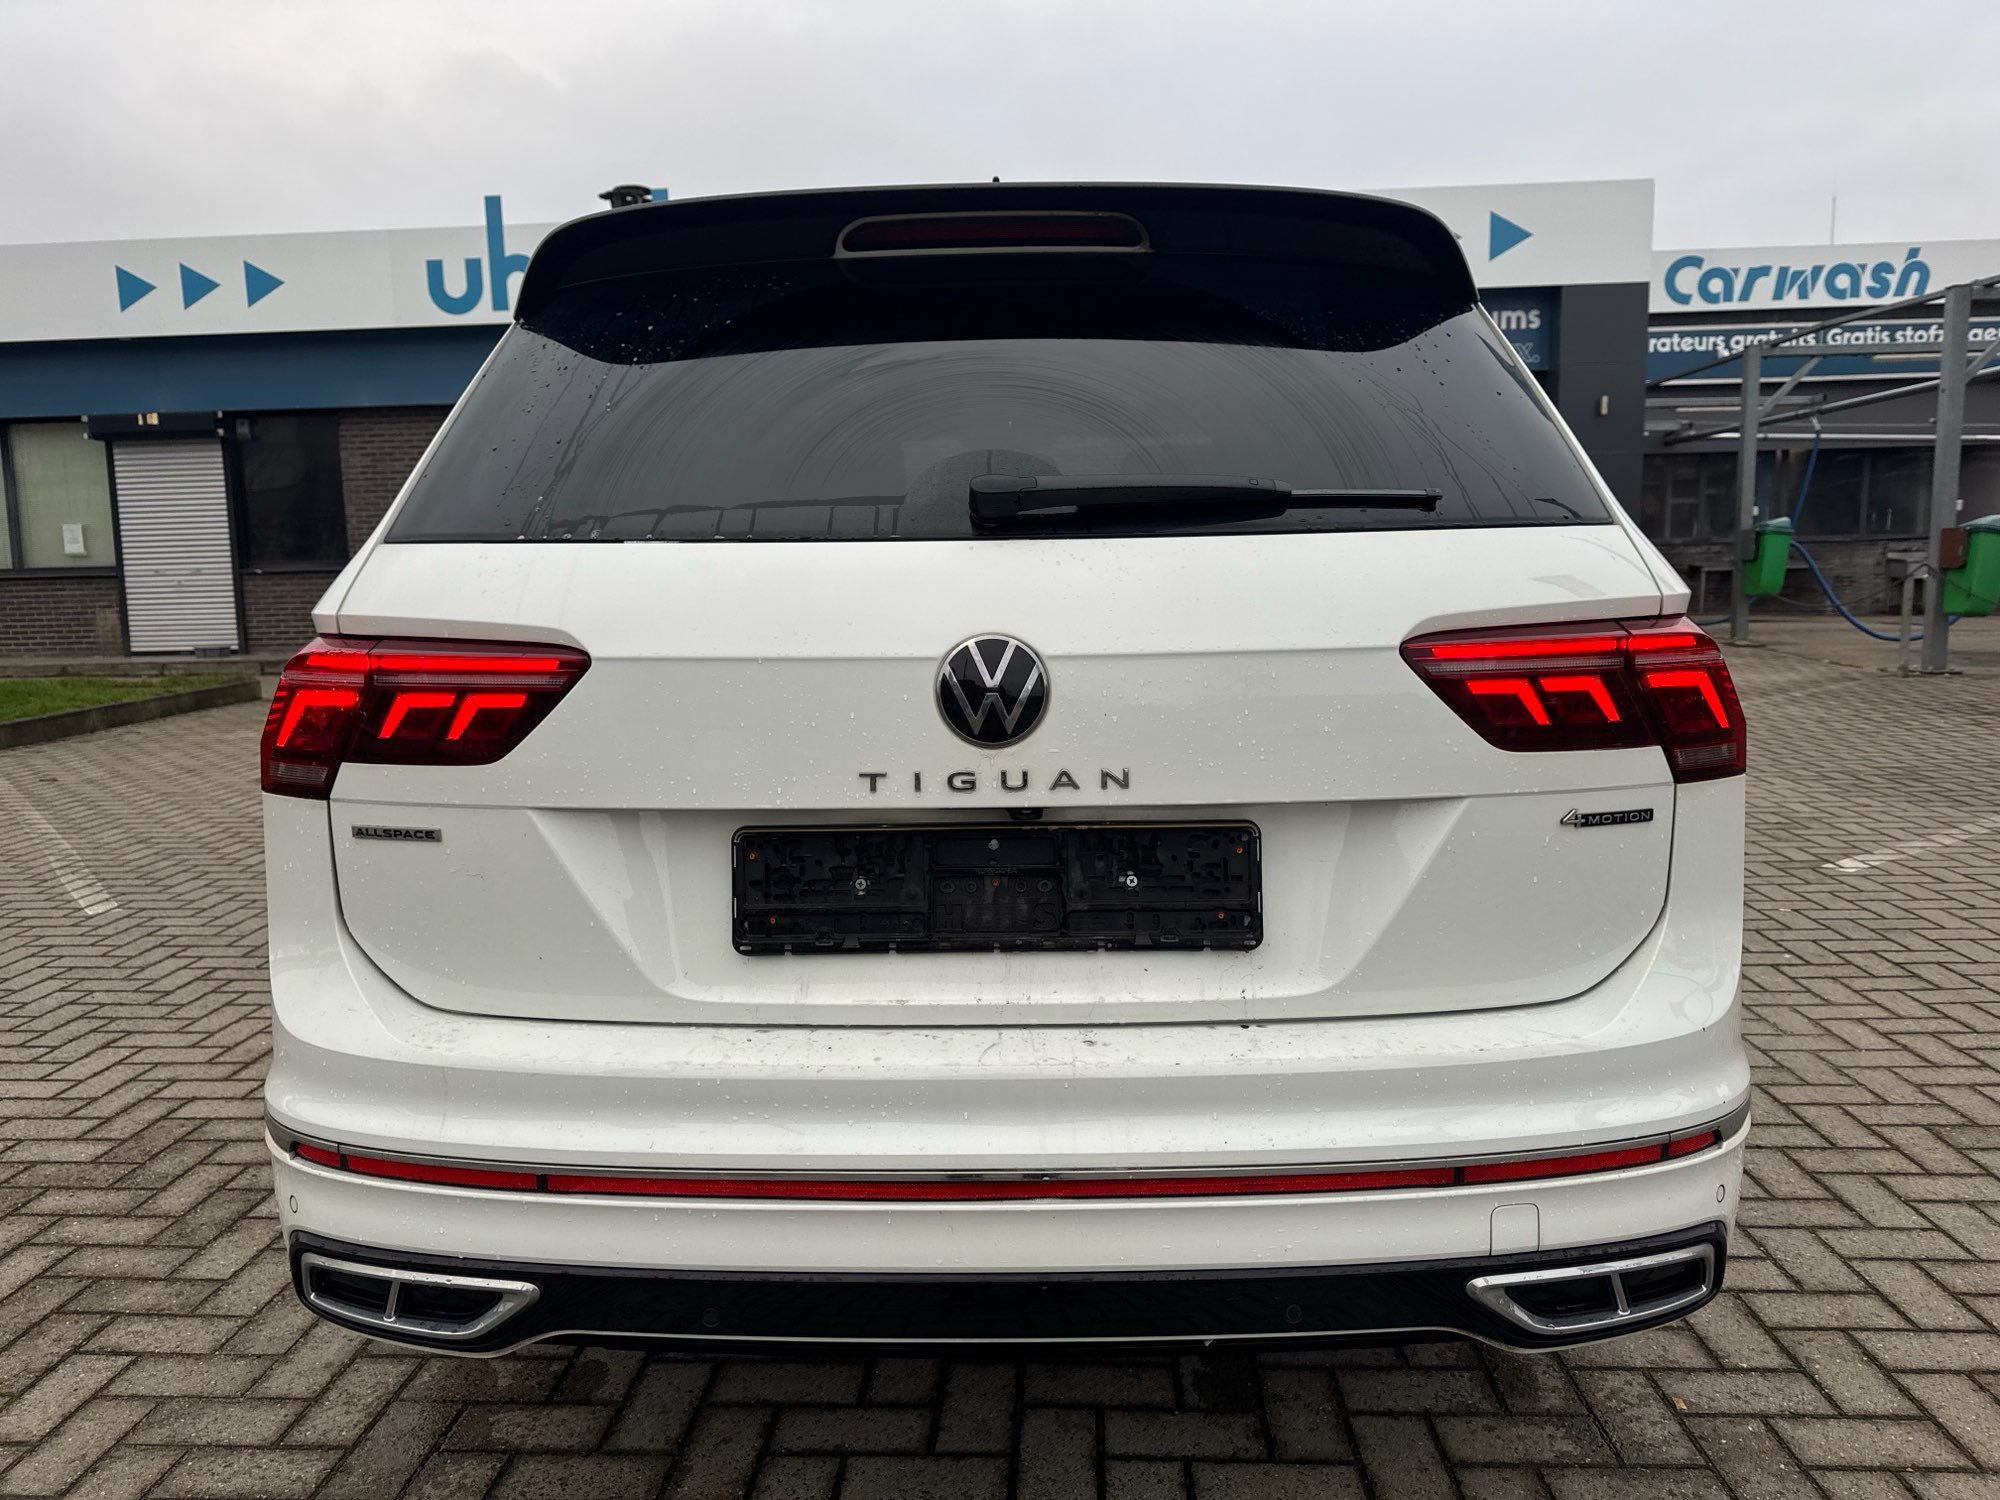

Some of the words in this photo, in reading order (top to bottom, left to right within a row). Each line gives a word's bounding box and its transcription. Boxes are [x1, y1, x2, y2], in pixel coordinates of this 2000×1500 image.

[1664, 247, 1931, 305] Carwash
[1826, 326, 1891, 345] Gratis
[858, 767, 1130, 793] TIGUAN
[354, 826, 437, 840] ALLSPACE
